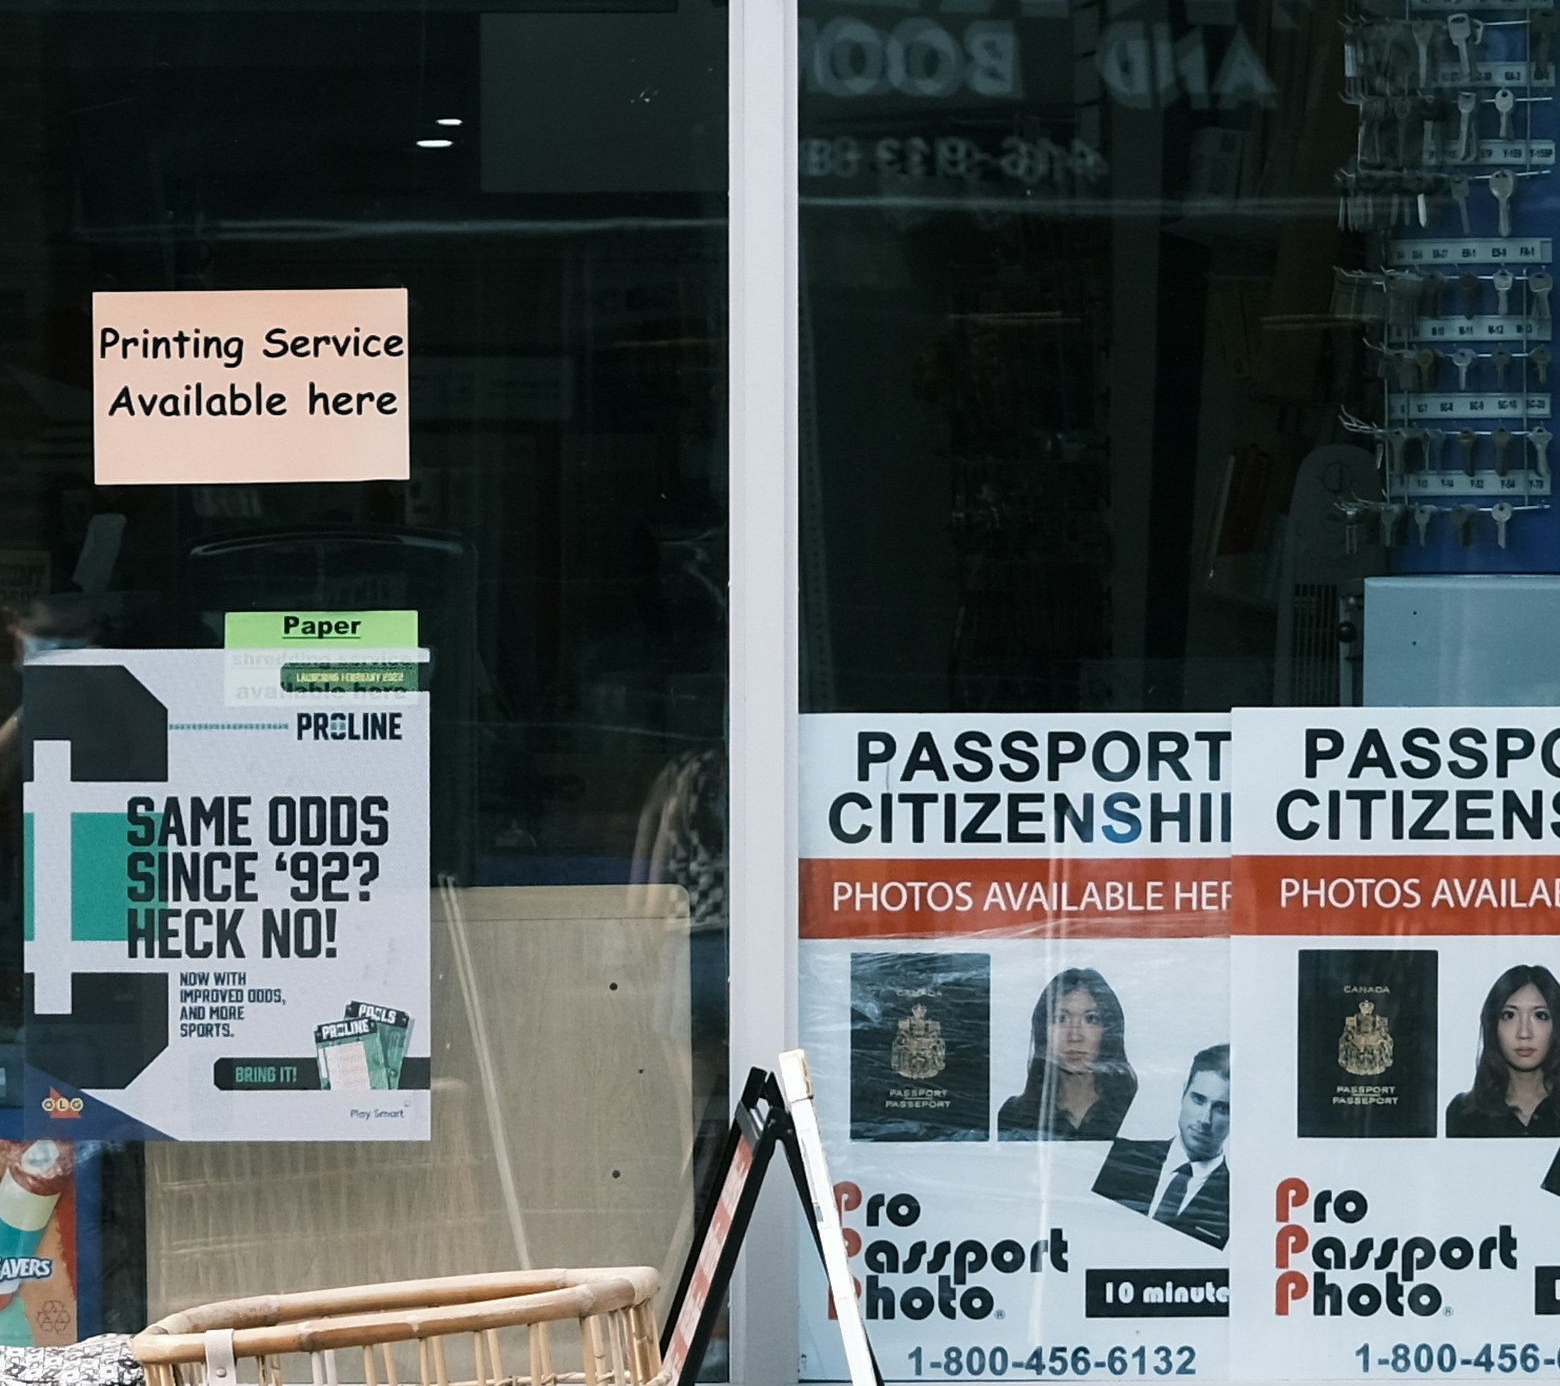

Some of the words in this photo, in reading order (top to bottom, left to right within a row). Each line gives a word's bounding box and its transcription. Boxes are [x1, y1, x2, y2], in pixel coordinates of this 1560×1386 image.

[97, 325, 244, 369] Printing
[262, 325, 405, 360] Service
[108, 381, 287, 418] Available
[309, 380, 399, 417] here
[282, 614, 361, 639] Paper
[296, 712, 403, 741] PROLINE
[856, 729, 1231, 783] PASSPORT
[127, 795, 252, 847] SAME
[268, 795, 389, 846] ODDS
[127, 851, 259, 903] SINCE
[833, 880, 974, 912] PHOTOS
[983, 880, 1164, 912] AVAILABLE
[1174, 880, 1231, 911] HER
[1280, 877, 1422, 909] PHOTOS
[127, 908, 246, 959] HECK
[262, 908, 338, 959] NO!
[179, 972, 210, 987] NOW
[213, 972, 247, 986] WITH
[1343, 985, 1390, 994] CANADA
[179, 989, 244, 1004] IMPROVED
[247, 989, 286, 1006] ODDS,
[179, 1006, 206, 1021] AND
[209, 1006, 245, 1020] MORE
[179, 1023, 235, 1038] SPORTS.
[321, 1017, 370, 1041] PROLINE
[235, 1067, 277, 1083] BRING
[279, 1067, 298, 1083] IT!
[889, 1089, 948, 1097] PASSPORT
[1332, 1097, 1399, 1105] PASSEPORT
[1336, 1086, 1396, 1094] PASSPORT
[349, 1108, 371, 1120] Play
[374, 1108, 405, 1119] Smart
[885, 1100, 951, 1109] PASSEPORT
[833, 1181, 921, 1227] Pro
[1275, 1176, 1369, 1223] Pro
[1275, 1223, 1517, 1282] Passport
[1105, 1281, 1134, 1303] 10
[1142, 1280, 1230, 1304] minute
[1275, 1269, 1443, 1318] Photo
[908, 1345, 1197, 1376] 1-800-456-6132
